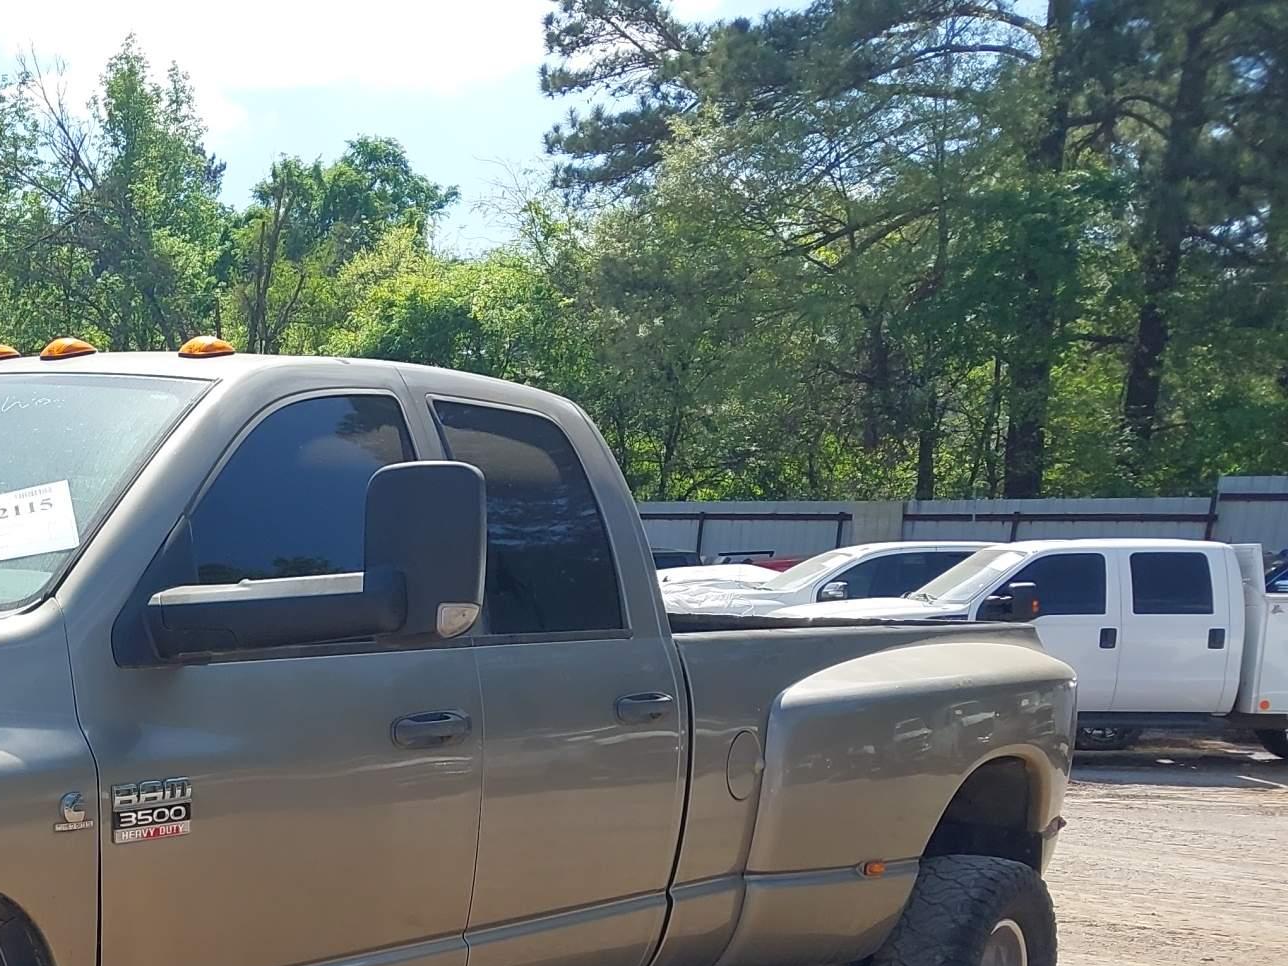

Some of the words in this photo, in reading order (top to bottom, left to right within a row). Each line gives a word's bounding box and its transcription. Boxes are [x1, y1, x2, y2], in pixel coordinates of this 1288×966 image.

[112, 776, 192, 808] RAM
[119, 805, 186, 828] 3500
[121, 827, 156, 841] HEAVY
[159, 823, 185, 835] DUTY
